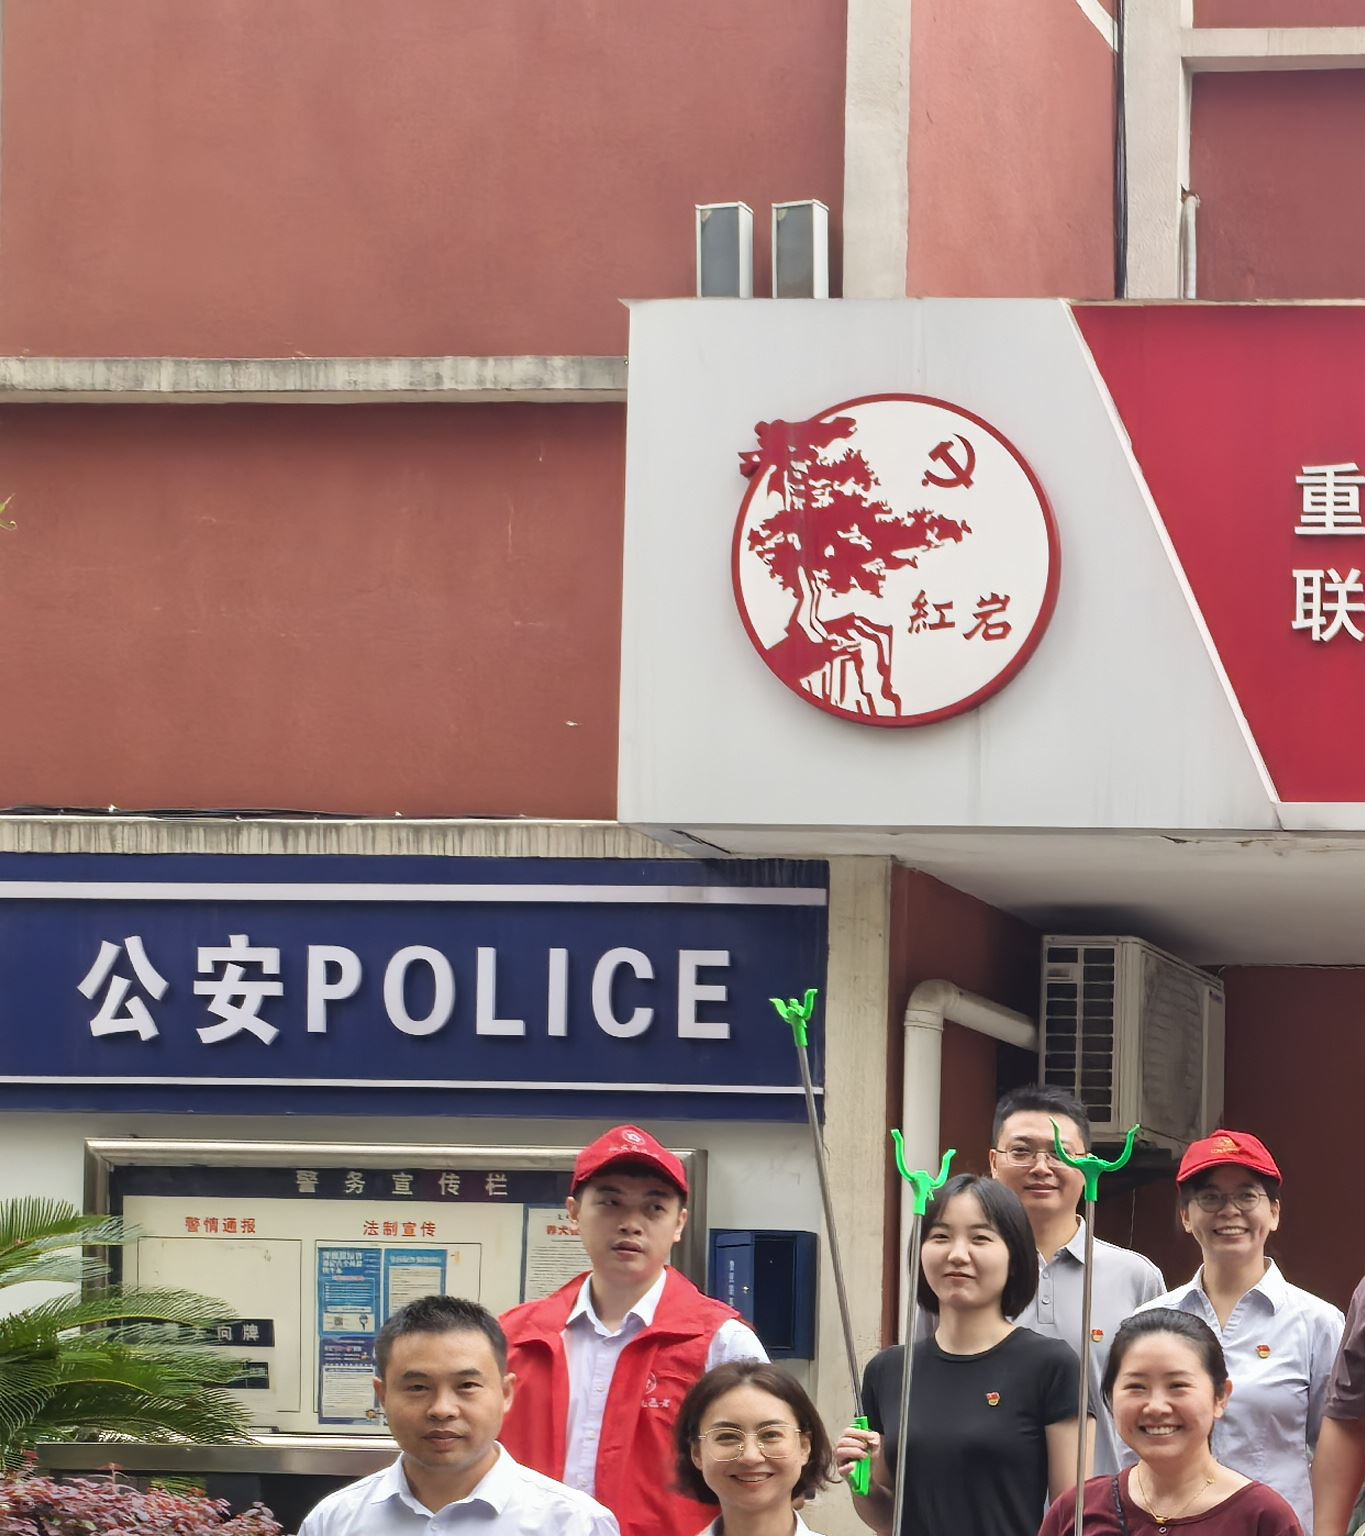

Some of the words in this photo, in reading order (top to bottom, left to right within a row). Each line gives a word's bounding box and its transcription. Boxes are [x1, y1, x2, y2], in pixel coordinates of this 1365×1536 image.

[77, 934, 732, 1045] 公安POLICE
[296, 1169, 508, 1197] 警务宣传栏
[184, 1215, 257, 1234] 警情通报
[362, 1219, 437, 1238] 法制宣传
